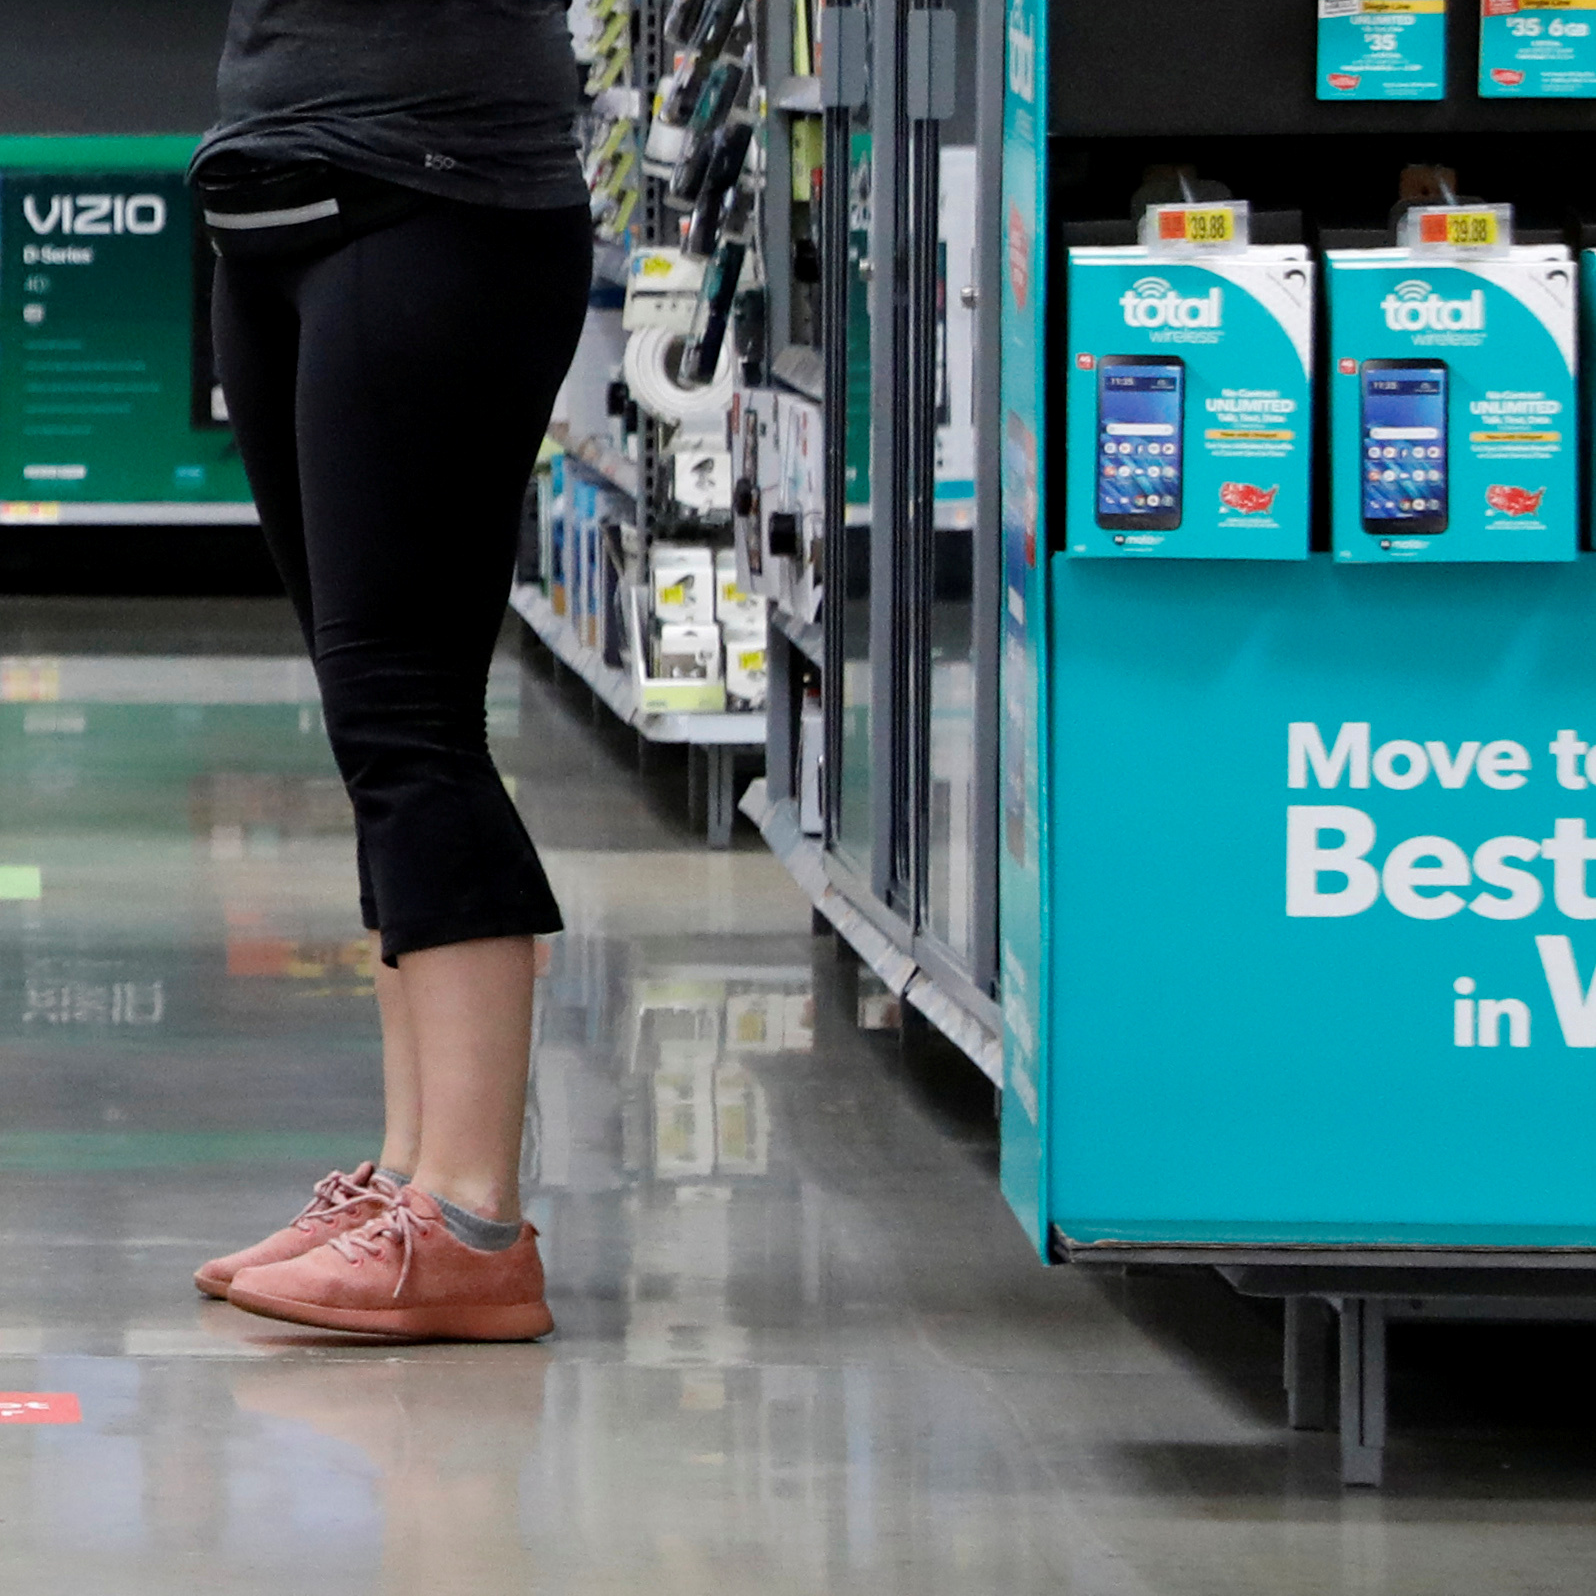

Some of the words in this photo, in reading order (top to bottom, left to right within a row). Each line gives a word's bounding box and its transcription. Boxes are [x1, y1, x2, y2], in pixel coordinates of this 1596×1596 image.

[1364, 34, 1398, 51] $35
[1548, 18, 1591, 36] 6GB
[23, 194, 166, 236] VIZIO
[1189, 215, 1226, 240] 39.88
[1120, 287, 1222, 328] total
[1381, 290, 1485, 331] total
[1205, 398, 1296, 413] UNLIMITED
[1470, 401, 1562, 414] UNLIMITED
[1288, 722, 1532, 790] Move
[1549, 729, 1596, 790] t
[1286, 804, 1596, 921] Best
[1453, 976, 1531, 1048] in
